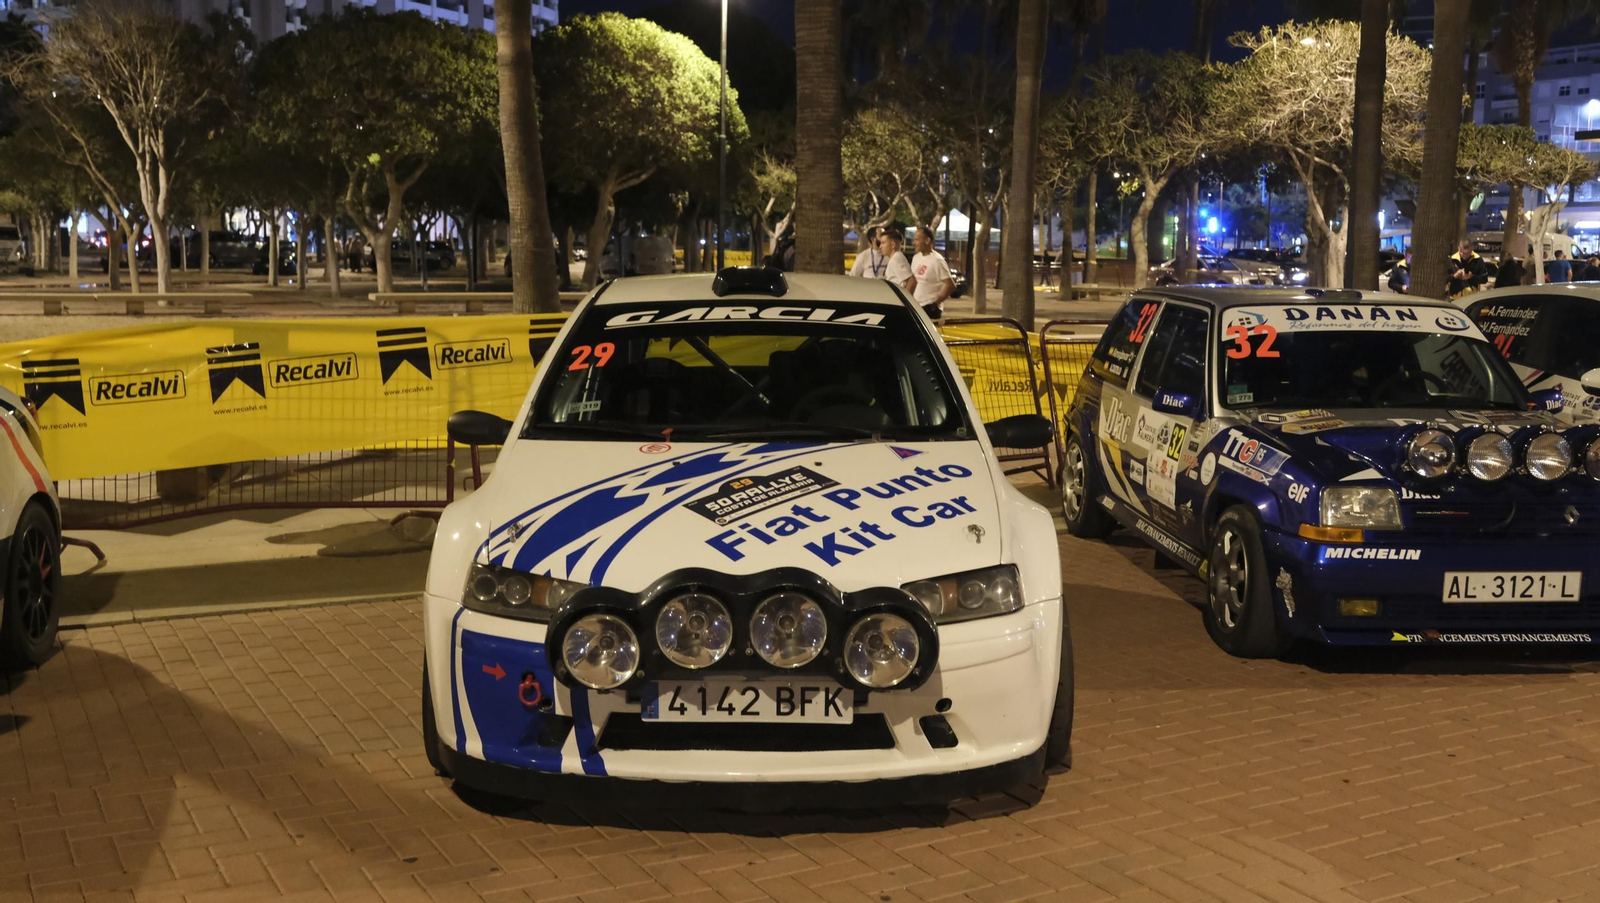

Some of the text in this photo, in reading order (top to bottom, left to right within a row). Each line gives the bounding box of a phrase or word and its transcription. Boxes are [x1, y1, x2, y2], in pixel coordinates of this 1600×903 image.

[605, 306, 886, 327] GARCIA
[1129, 303, 1158, 343] 32
[1488, 306, 1538, 319] A.Fernández
[1484, 322, 1530, 336] V.Fernández
[1226, 324, 1280, 359] 32
[440, 343, 506, 365] Recalvi
[568, 343, 615, 371] 29
[275, 357, 352, 383] Recalvi
[96, 375, 179, 401] Recalvi
[383, 385, 434, 396] www.recalvi.es
[213, 404, 267, 415] www.recalvi.es
[1162, 394, 1184, 408] Diac
[1105, 397, 1130, 443] Diac
[1169, 426, 1185, 459] 32
[1223, 428, 1258, 463] TTC
[705, 473, 807, 511] 50 RALLYE
[730, 478, 753, 489] 29
[1288, 482, 1310, 504] elf
[705, 464, 972, 562] Fiat Punto
[716, 499, 752, 515] COSTA
[752, 495, 768, 503] DE
[803, 495, 977, 567] Kit Car
[1177, 546, 1200, 566] RENAULT
[1324, 547, 1421, 560] MICHELIN
[1501, 633, 1592, 643] FINANCEMENTS
[668, 686, 844, 717] 4142 BFK
